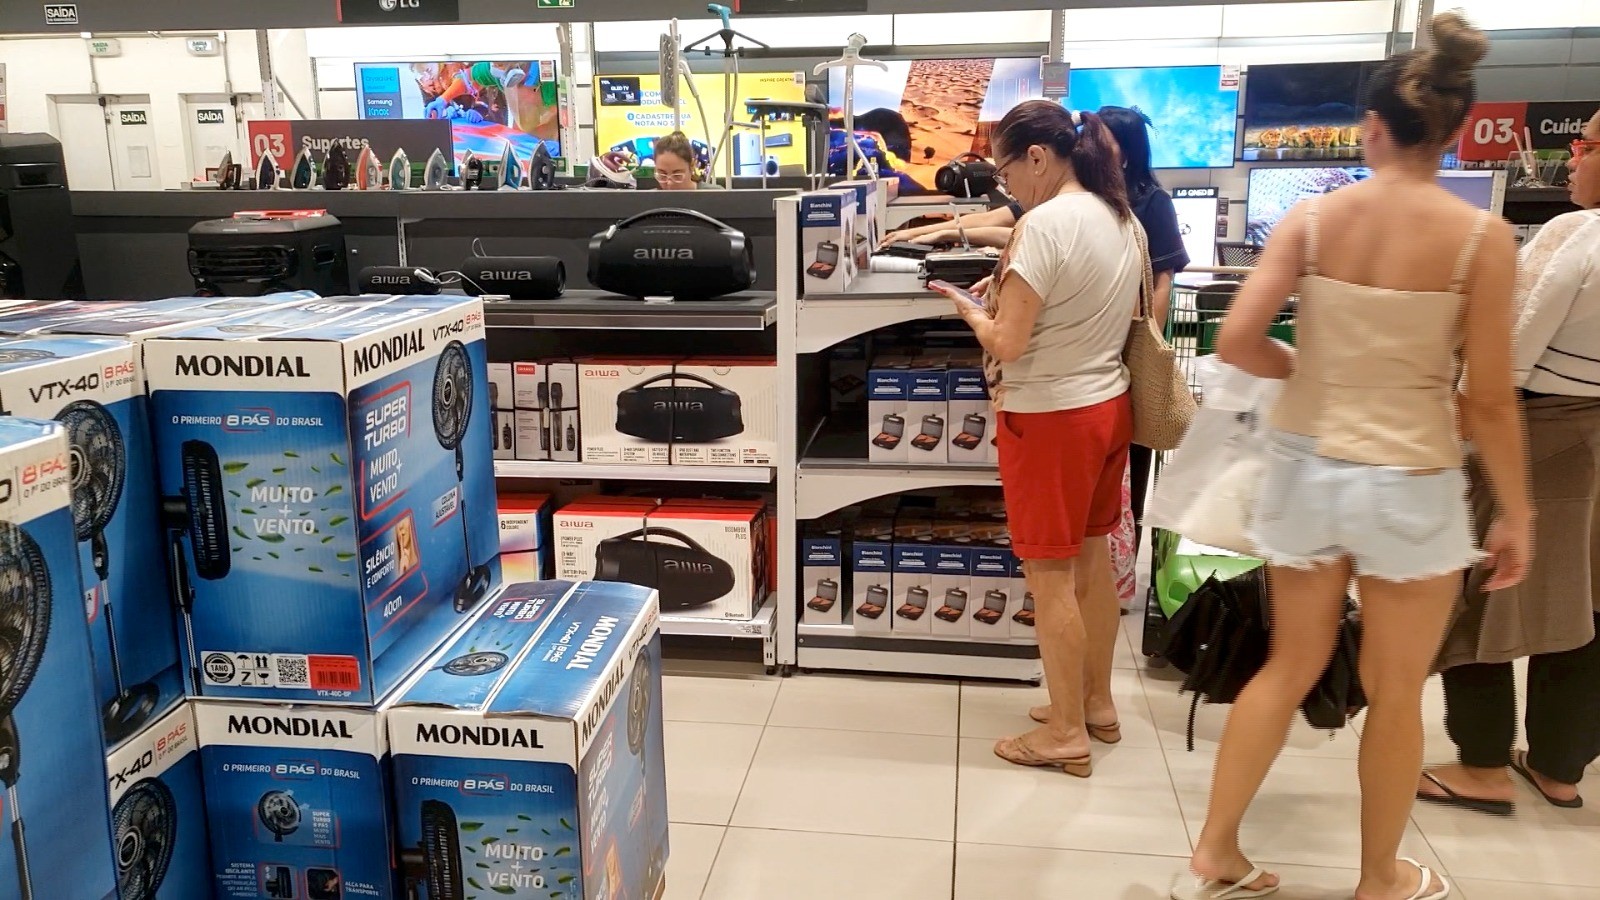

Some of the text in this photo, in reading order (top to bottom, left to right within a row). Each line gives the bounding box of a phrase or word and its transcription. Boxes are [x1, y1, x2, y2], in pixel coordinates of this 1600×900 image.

[47, 7, 76, 18] SAÍDA
[120, 110, 146, 123] SAÍDA
[198, 110, 223, 122] SAÍDA
[368, 108, 390, 116] Knox
[1474, 118, 1514, 144] 03
[254, 134, 286, 158] 03
[633, 248, 694, 260] aiwa
[371, 275, 410, 285] aiwa
[480, 270, 532, 282] aiwa
[354, 328, 425, 377] MONDIAL
[433, 320, 464, 341] VTX-40
[176, 355, 310, 377] MONDIAL
[584, 370, 620, 378] aiwa
[29, 373, 99, 404] VTX-40
[104, 366, 114, 379] 8
[116, 361, 134, 376] PÁS
[172, 414, 324, 426] O PRIMEIRO 8 PÁS DO BRASIL
[366, 396, 406, 431] SUPER
[364, 416, 406, 451] TURBO
[370, 448, 397, 480] MUITO
[22, 465, 37, 484] 8
[251, 486, 314, 504] MUITO
[370, 472, 397, 503] VENTO
[253, 518, 316, 535] VENTO
[501, 520, 506, 530] 6
[366, 541, 394, 574] SILÊNCIO
[664, 560, 714, 574] aiwa
[372, 560, 394, 585] CONFORTO
[384, 595, 402, 618] 40cm
[566, 616, 619, 670] MONDIAL
[582, 658, 624, 748] MONDIAL
[228, 715, 353, 738] MONDIAL
[156, 736, 166, 751] 8
[167, 722, 186, 741] PÁS
[416, 723, 544, 750] MONDIAL
[223, 762, 360, 780] O PRIMEIRO 8 PÁS DO BRASIL
[412, 776, 554, 794] O PRIMEIRO 8 PÁS DO BRASIL
[485, 843, 544, 862] MUITO
[486, 872, 545, 889] VENTO
